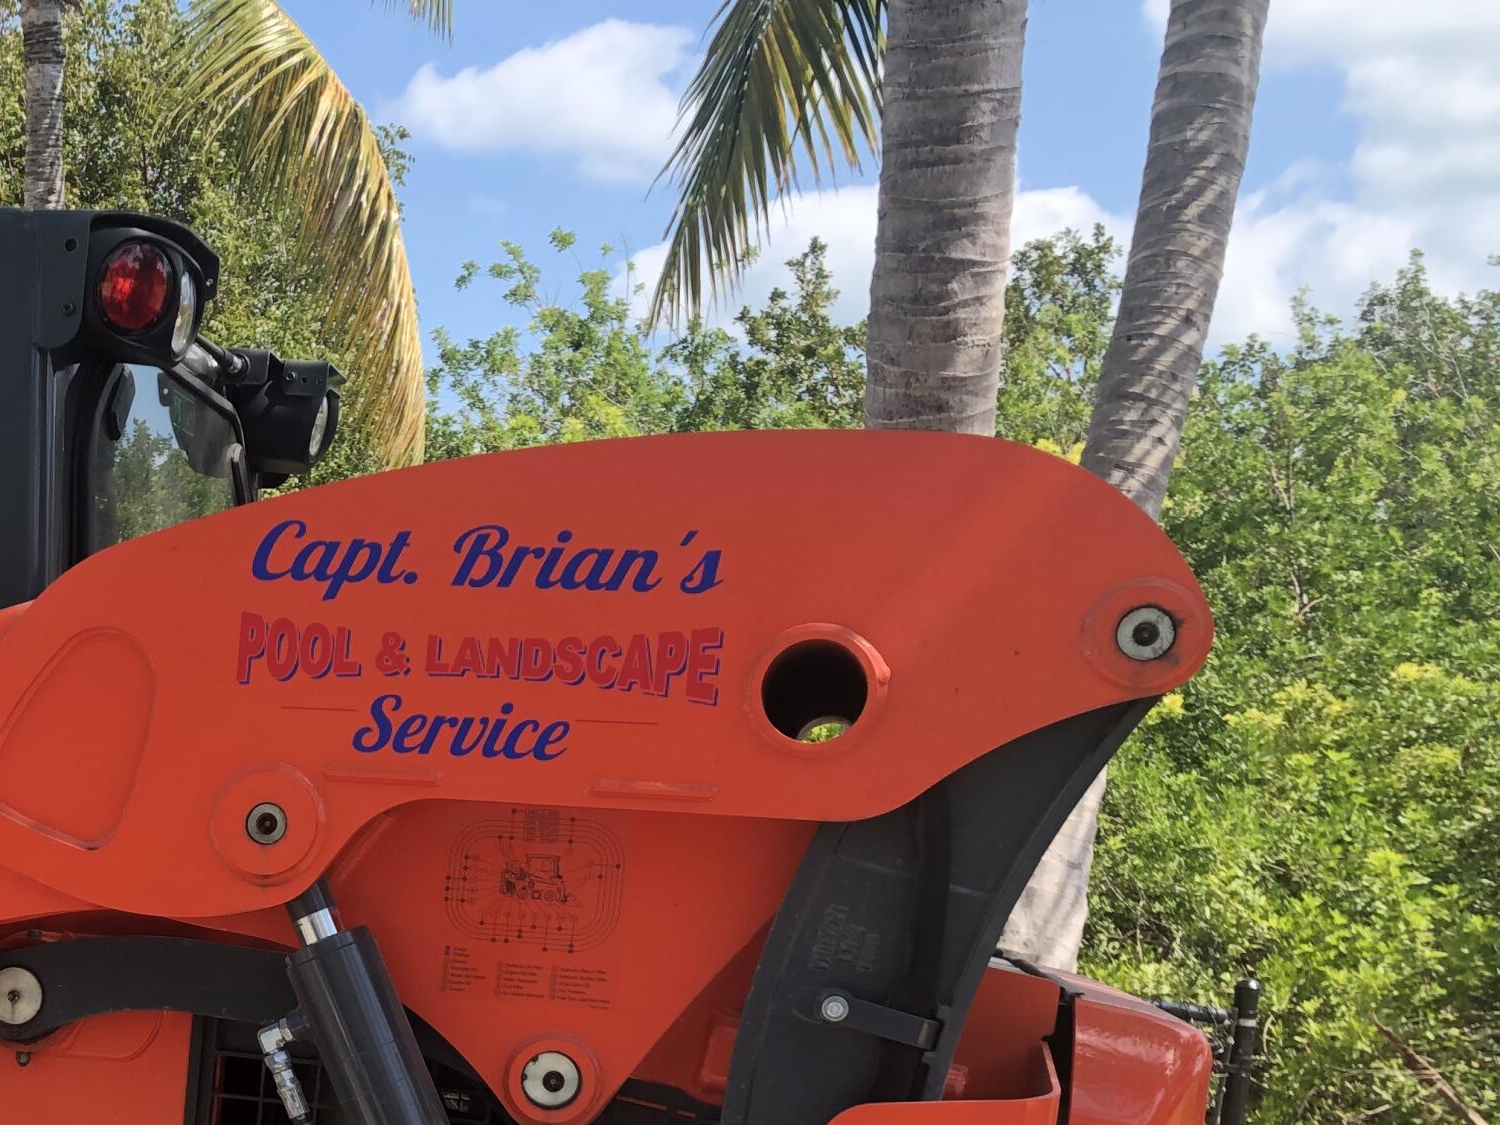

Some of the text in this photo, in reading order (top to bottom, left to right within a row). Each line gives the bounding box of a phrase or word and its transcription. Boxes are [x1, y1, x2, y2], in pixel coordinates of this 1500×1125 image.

[251, 519, 724, 601] Capt. Brian's
[236, 611, 724, 706] POOL & LANDSCAPE
[352, 694, 571, 761] Service
